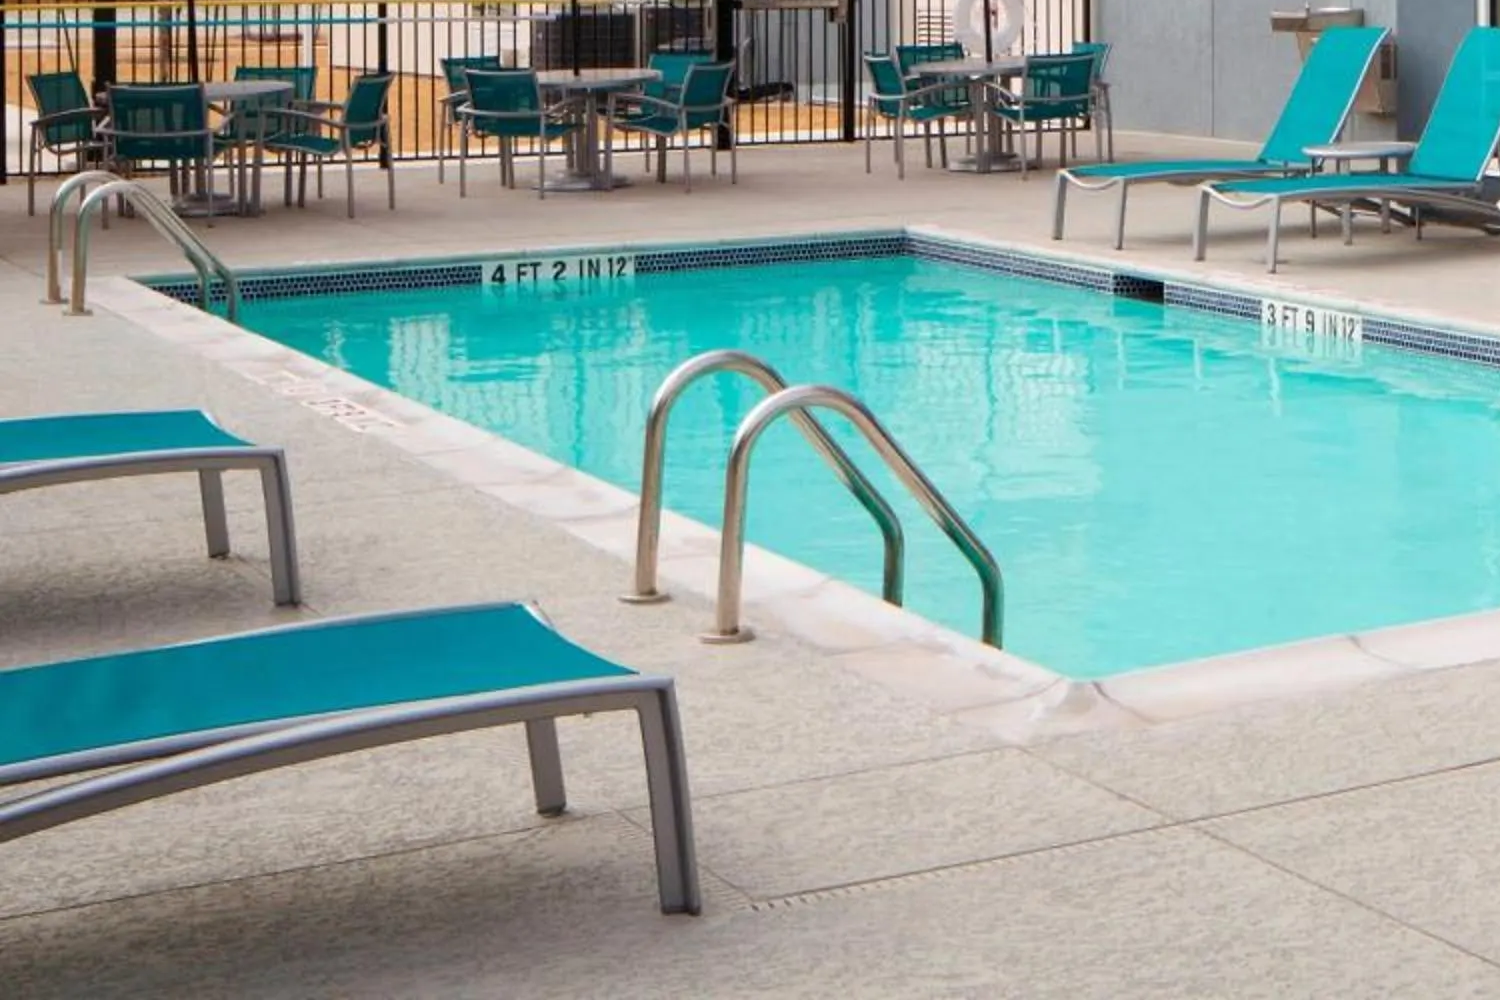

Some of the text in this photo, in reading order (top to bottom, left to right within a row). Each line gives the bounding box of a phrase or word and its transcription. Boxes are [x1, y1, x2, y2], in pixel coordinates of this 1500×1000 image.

[491, 264, 506, 283] 4
[516, 262, 542, 282] FT
[552, 261, 567, 280] 2
[579, 258, 601, 280] IN
[1267, 303, 1277, 326] 3
[1282, 305, 1299, 328] FT
[1305, 310, 1315, 334] 9
[1323, 311, 1337, 337] IN
